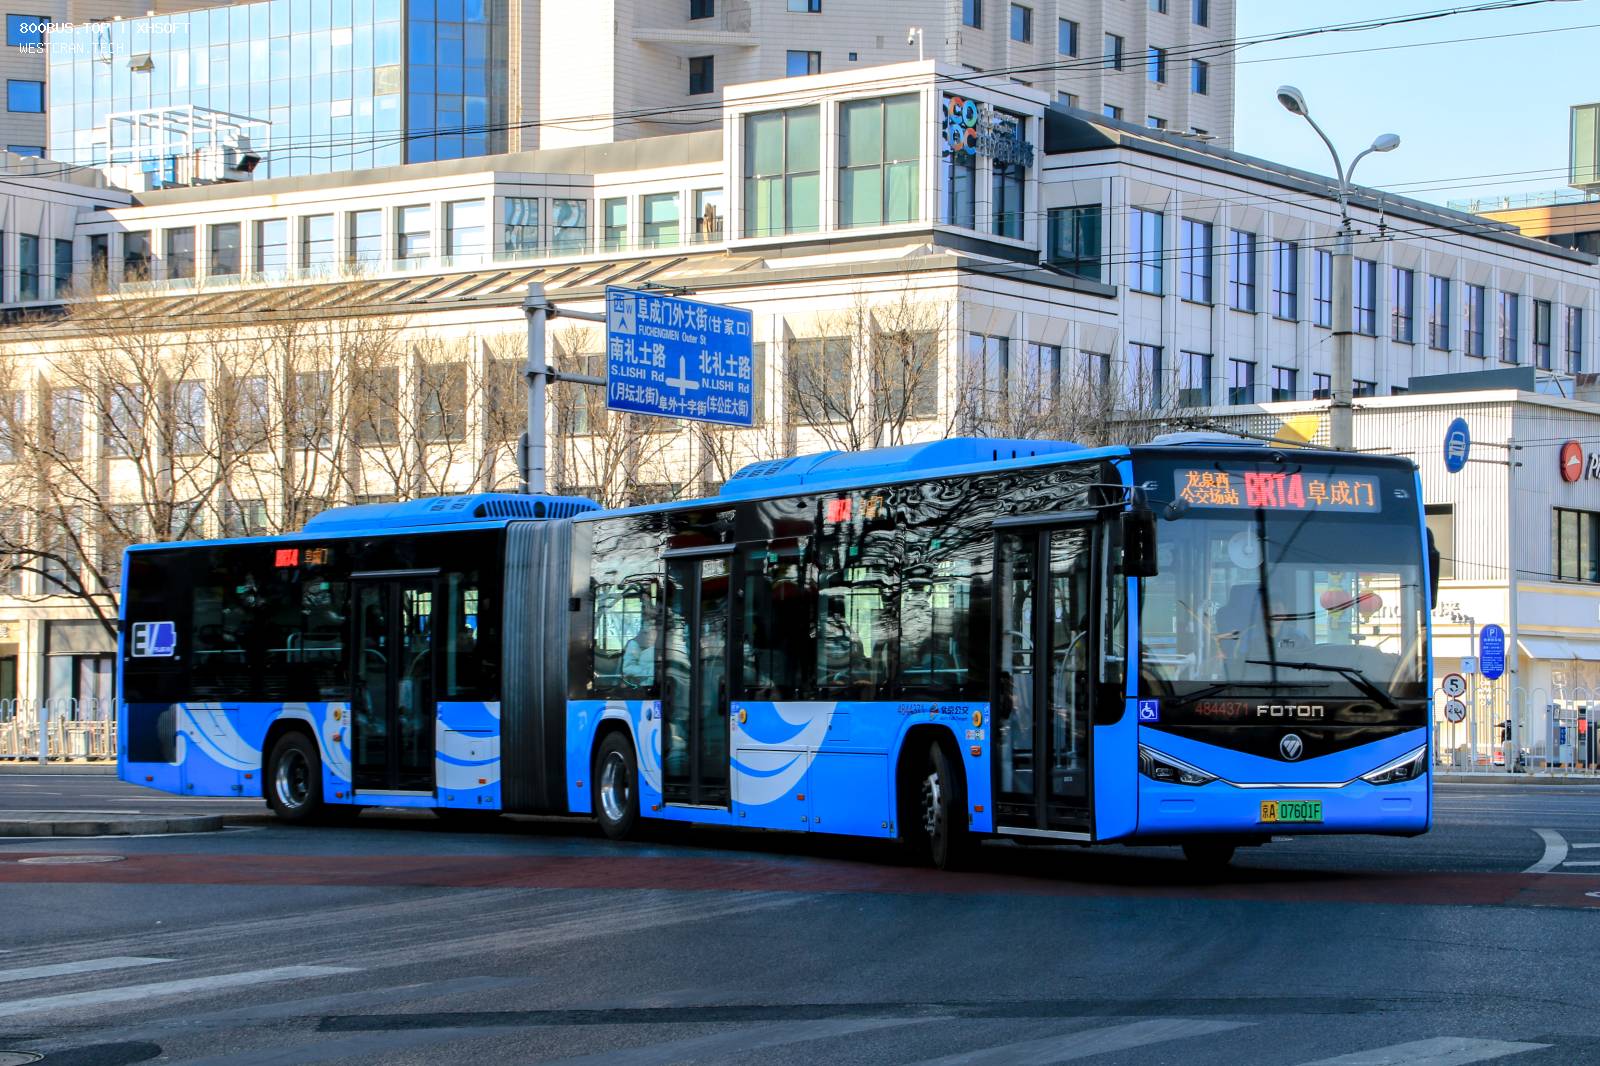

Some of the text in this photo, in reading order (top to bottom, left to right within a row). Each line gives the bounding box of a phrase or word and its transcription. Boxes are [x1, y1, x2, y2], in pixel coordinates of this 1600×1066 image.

[611, 364, 665, 382] S.LISHI Rd
[702, 378, 750, 394] N.LISHI Rd
[1180, 488, 1239, 506] 公交场站
[1244, 471, 1305, 508] BRT4
[1307, 479, 1374, 506] 阜成门
[1450, 679, 1459, 692] 5
[1195, 702, 1249, 716] 4844371
[1257, 705, 1324, 717] FOTON
